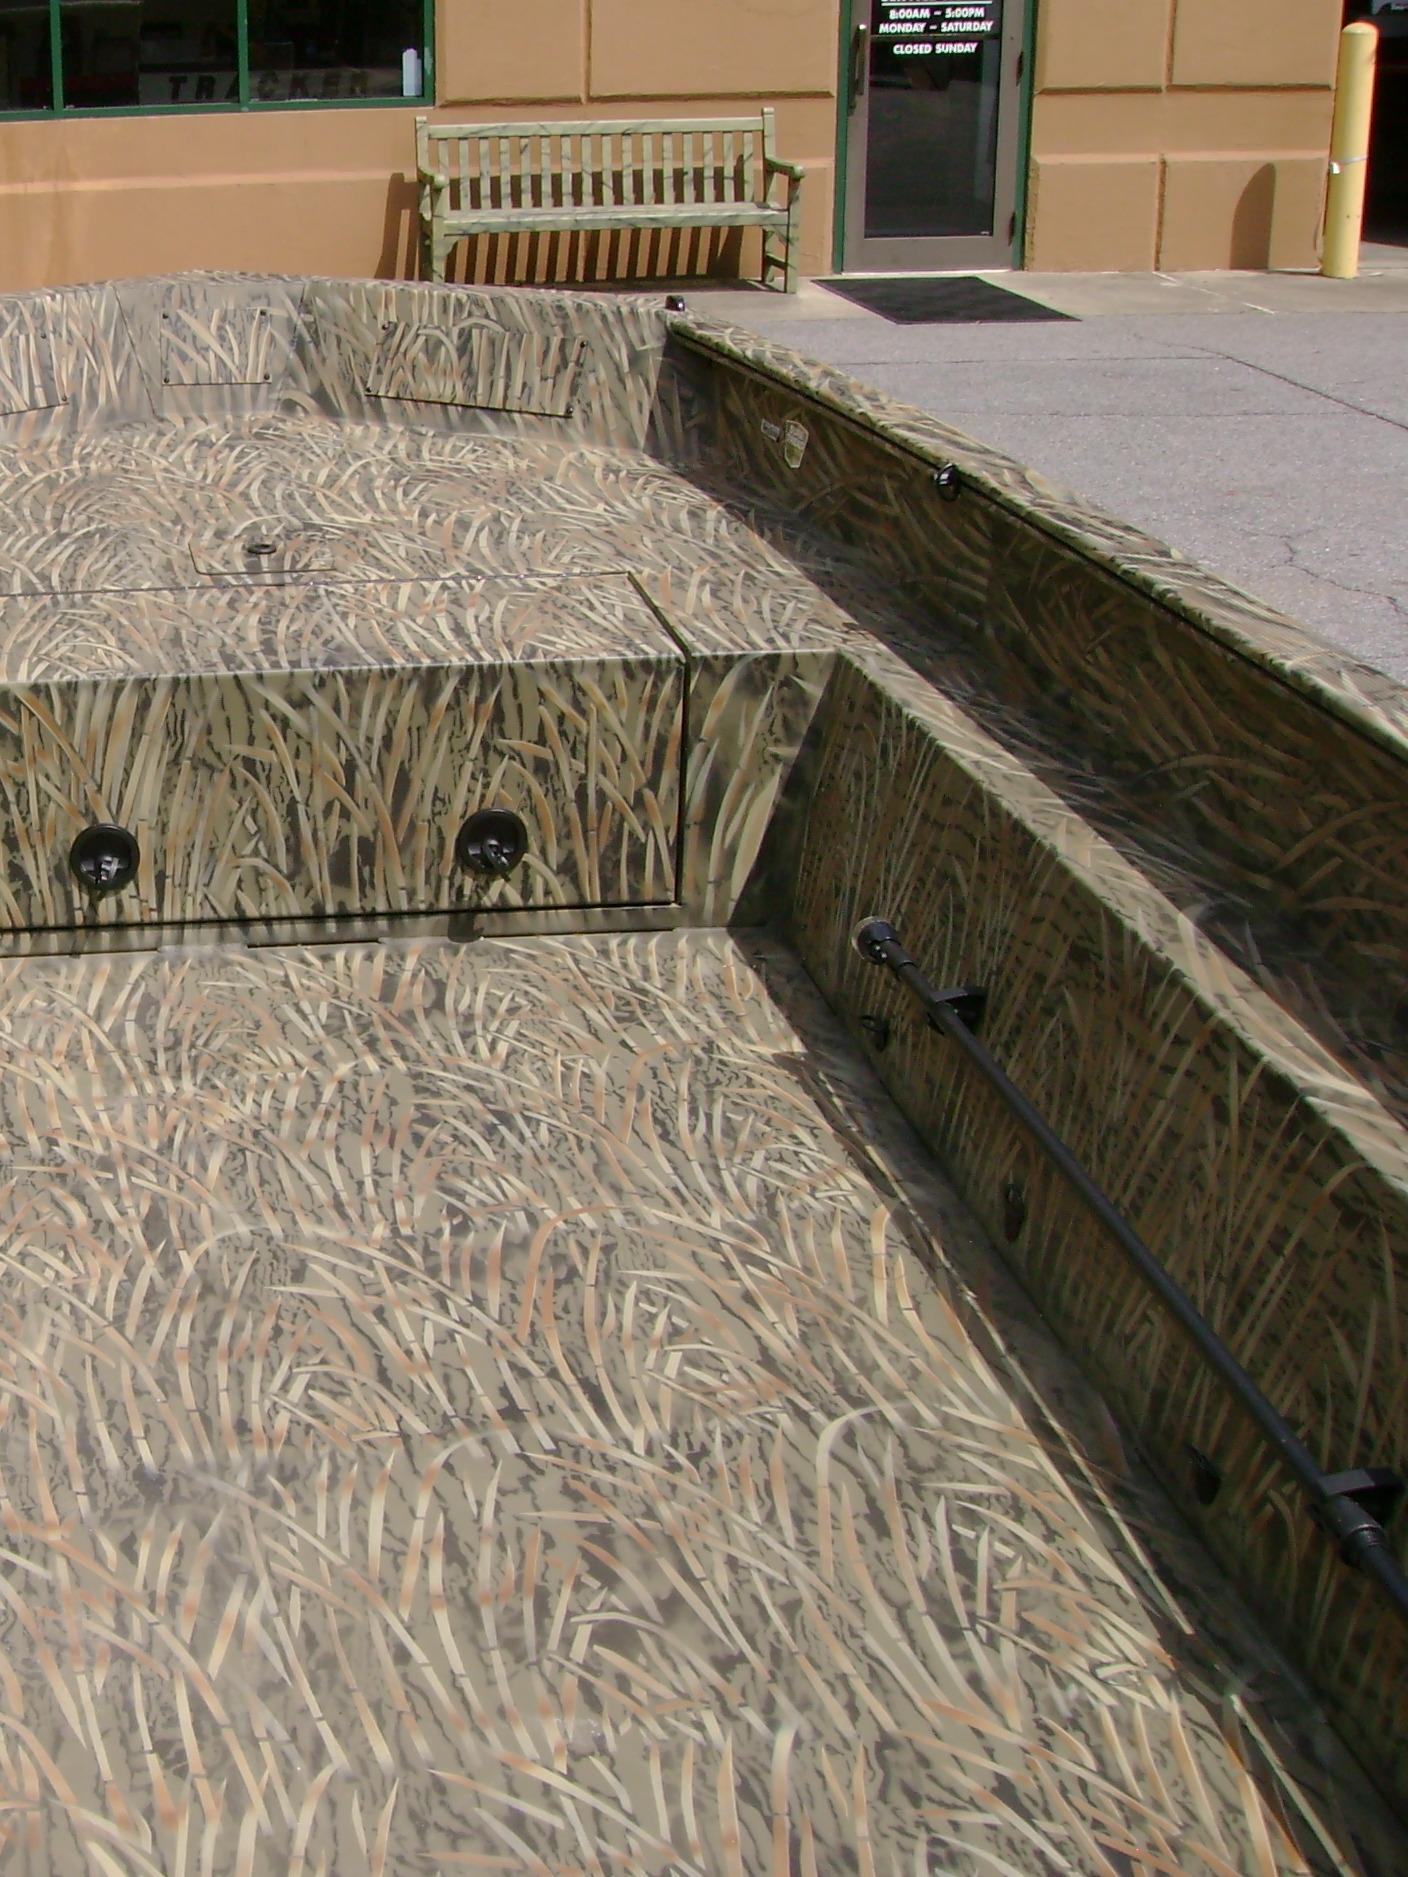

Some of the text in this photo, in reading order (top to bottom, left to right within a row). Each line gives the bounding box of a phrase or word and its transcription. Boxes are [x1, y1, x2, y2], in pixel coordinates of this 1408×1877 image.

[879, 22, 926, 33] MONDAY
[941, 21, 993, 32] SATURDAY
[893, 42, 978, 54] CLOSED SUNDAY
